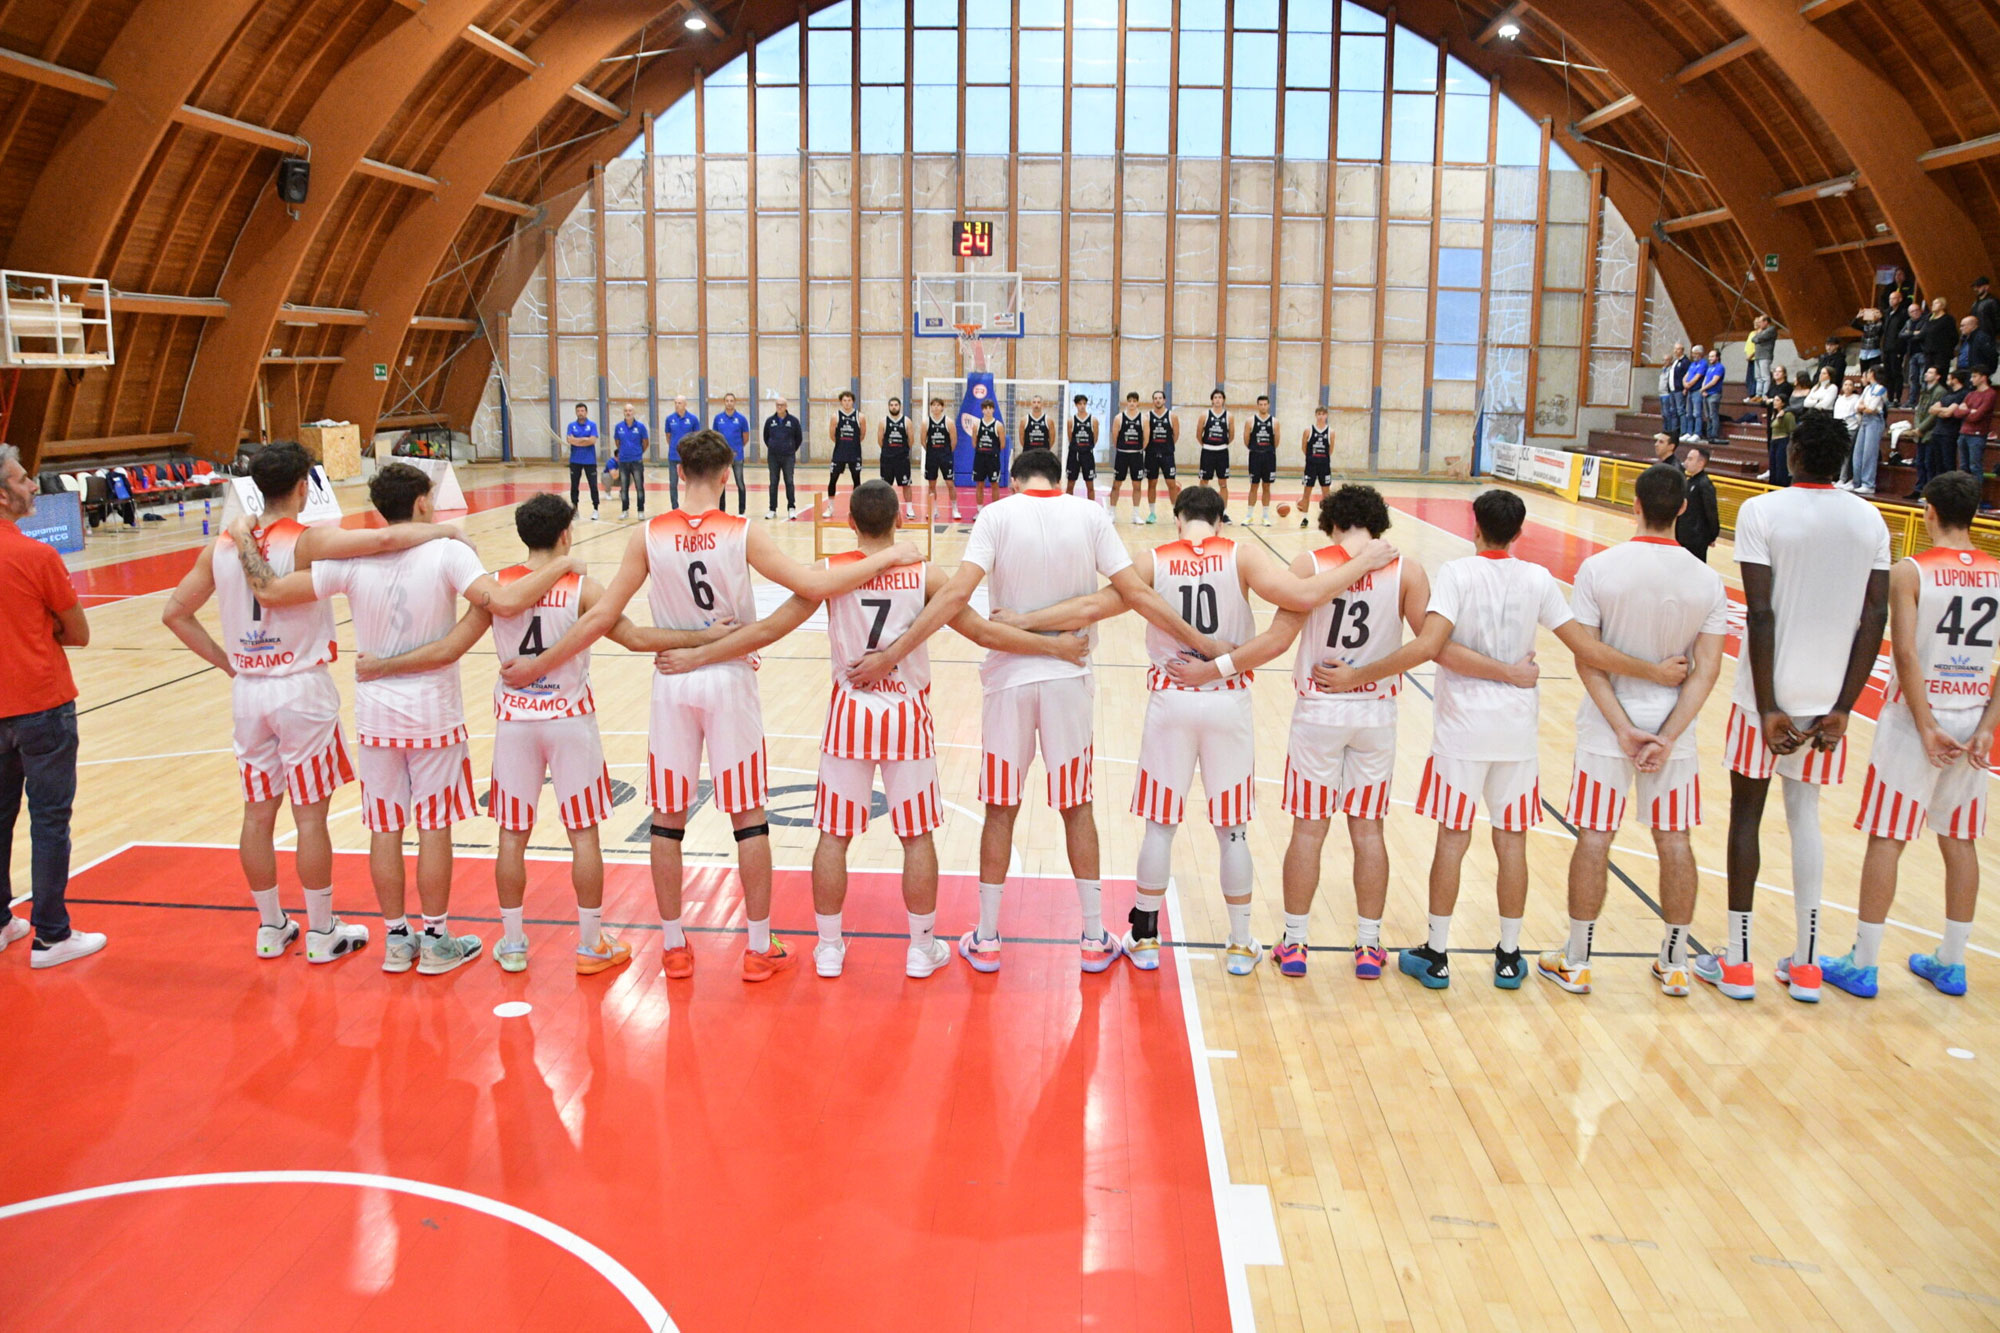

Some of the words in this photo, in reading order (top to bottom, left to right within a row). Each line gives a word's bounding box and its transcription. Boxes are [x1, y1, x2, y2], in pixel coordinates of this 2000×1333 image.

[961, 233, 988, 255] 24
[50, 533, 69, 542] ECG
[675, 532, 716, 552] FABRIS
[688, 560, 714, 610] 6
[861, 599, 891, 649] 7
[1179, 583, 1218, 634] 10
[1326, 597, 1370, 649] 13
[1936, 595, 1998, 647] 42
[519, 616, 550, 657] 4
[233, 651, 294, 669] TERAMO
[503, 692, 567, 711] TERAMO
